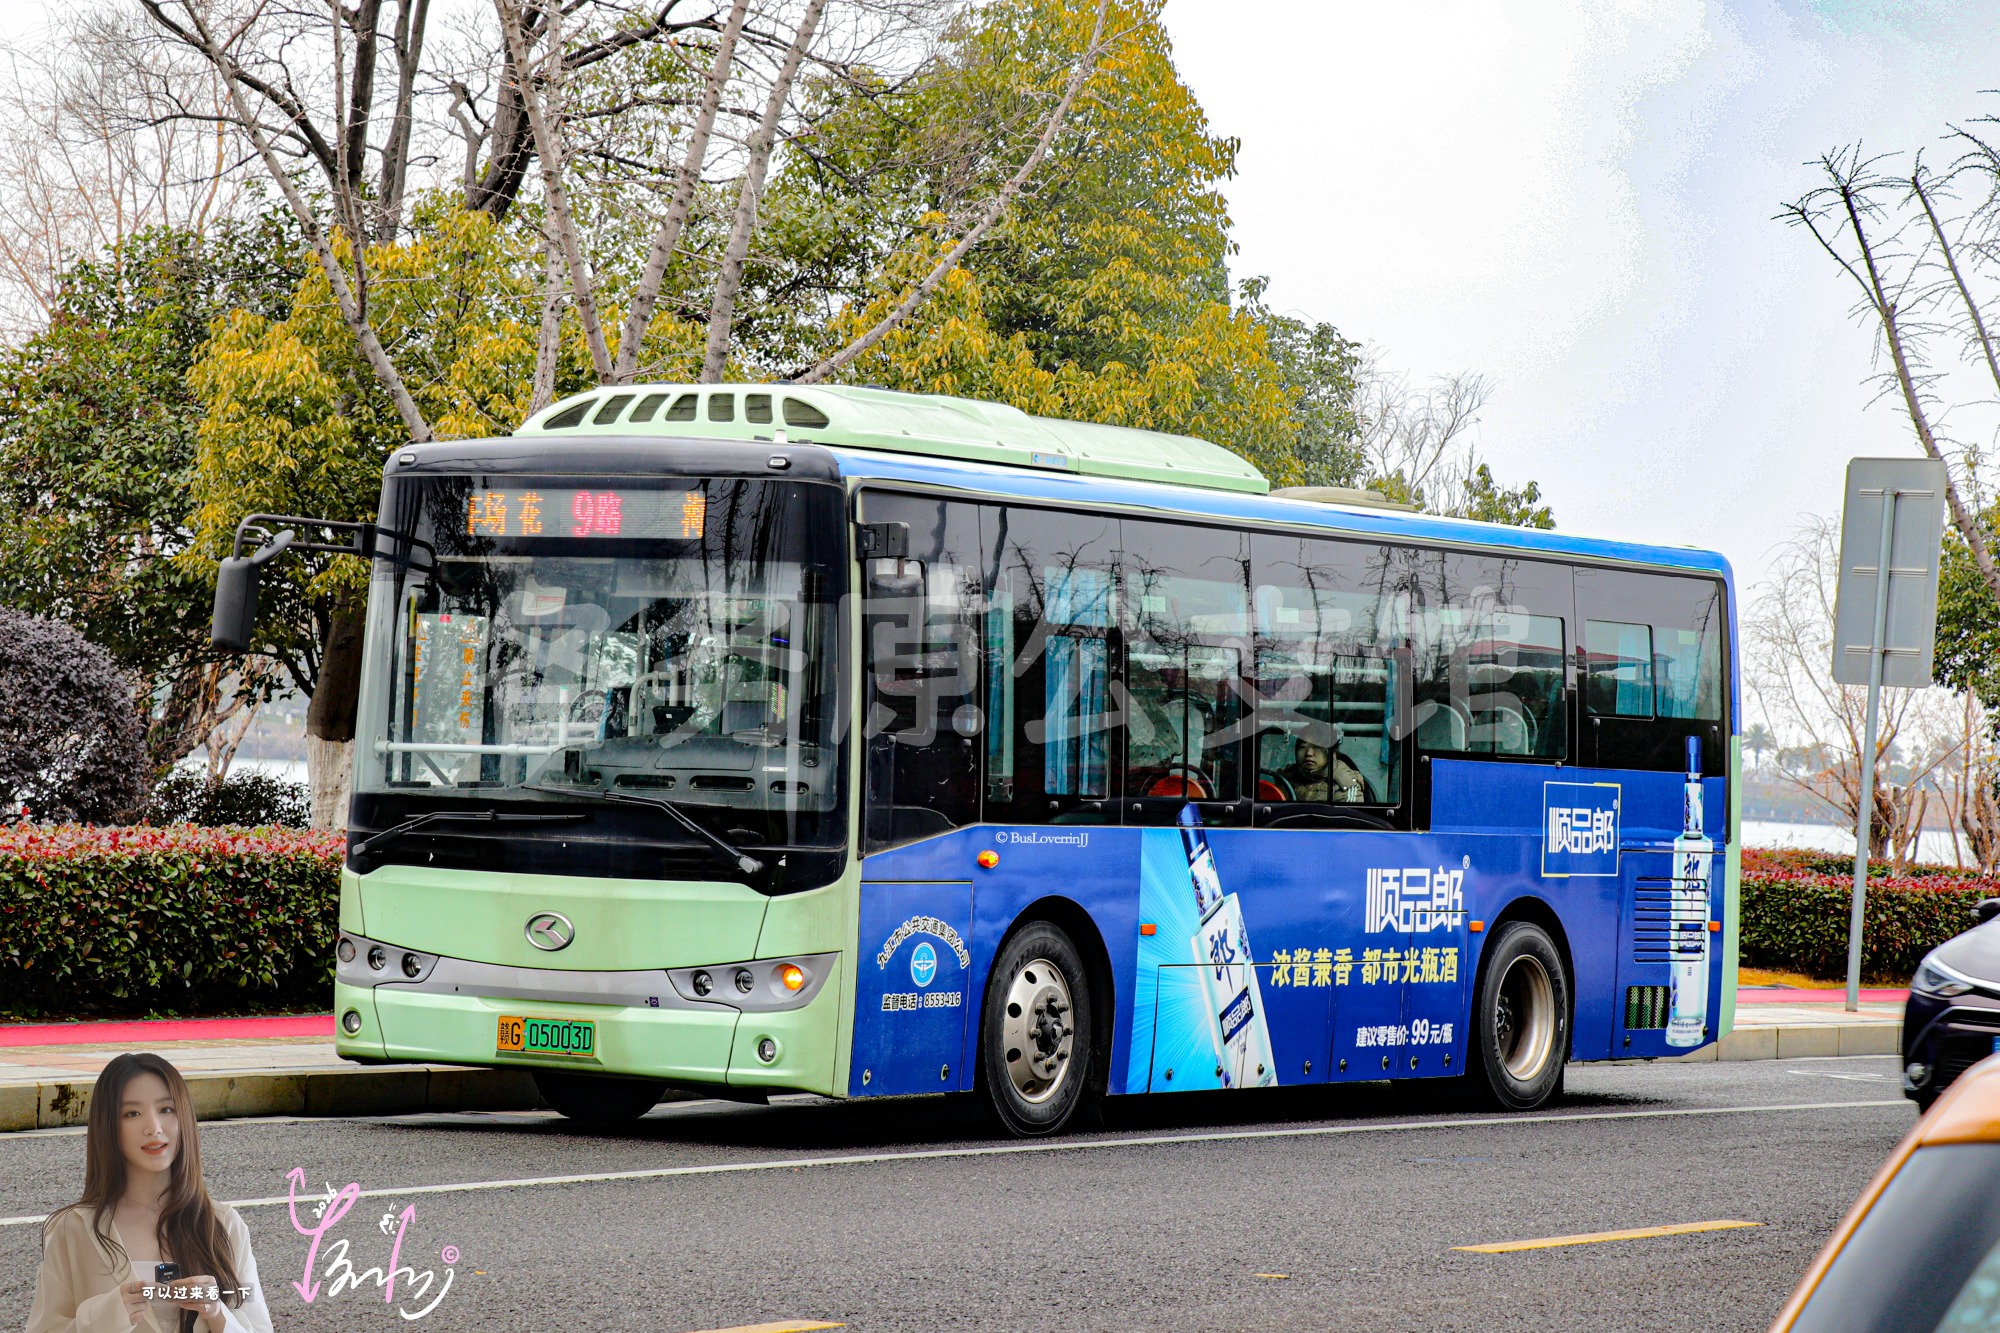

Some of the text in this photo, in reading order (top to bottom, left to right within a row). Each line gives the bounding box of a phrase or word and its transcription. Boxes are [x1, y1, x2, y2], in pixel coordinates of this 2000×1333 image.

[573, 491, 623, 537] 9路
[1548, 806, 1615, 855] 顺品郎
[1364, 865, 1465, 934] 顺品郎
[877, 915, 970, 970] 九江市公共交通集团公司
[1270, 946, 1459, 988] 浓酱兼香 都市光瓶酒
